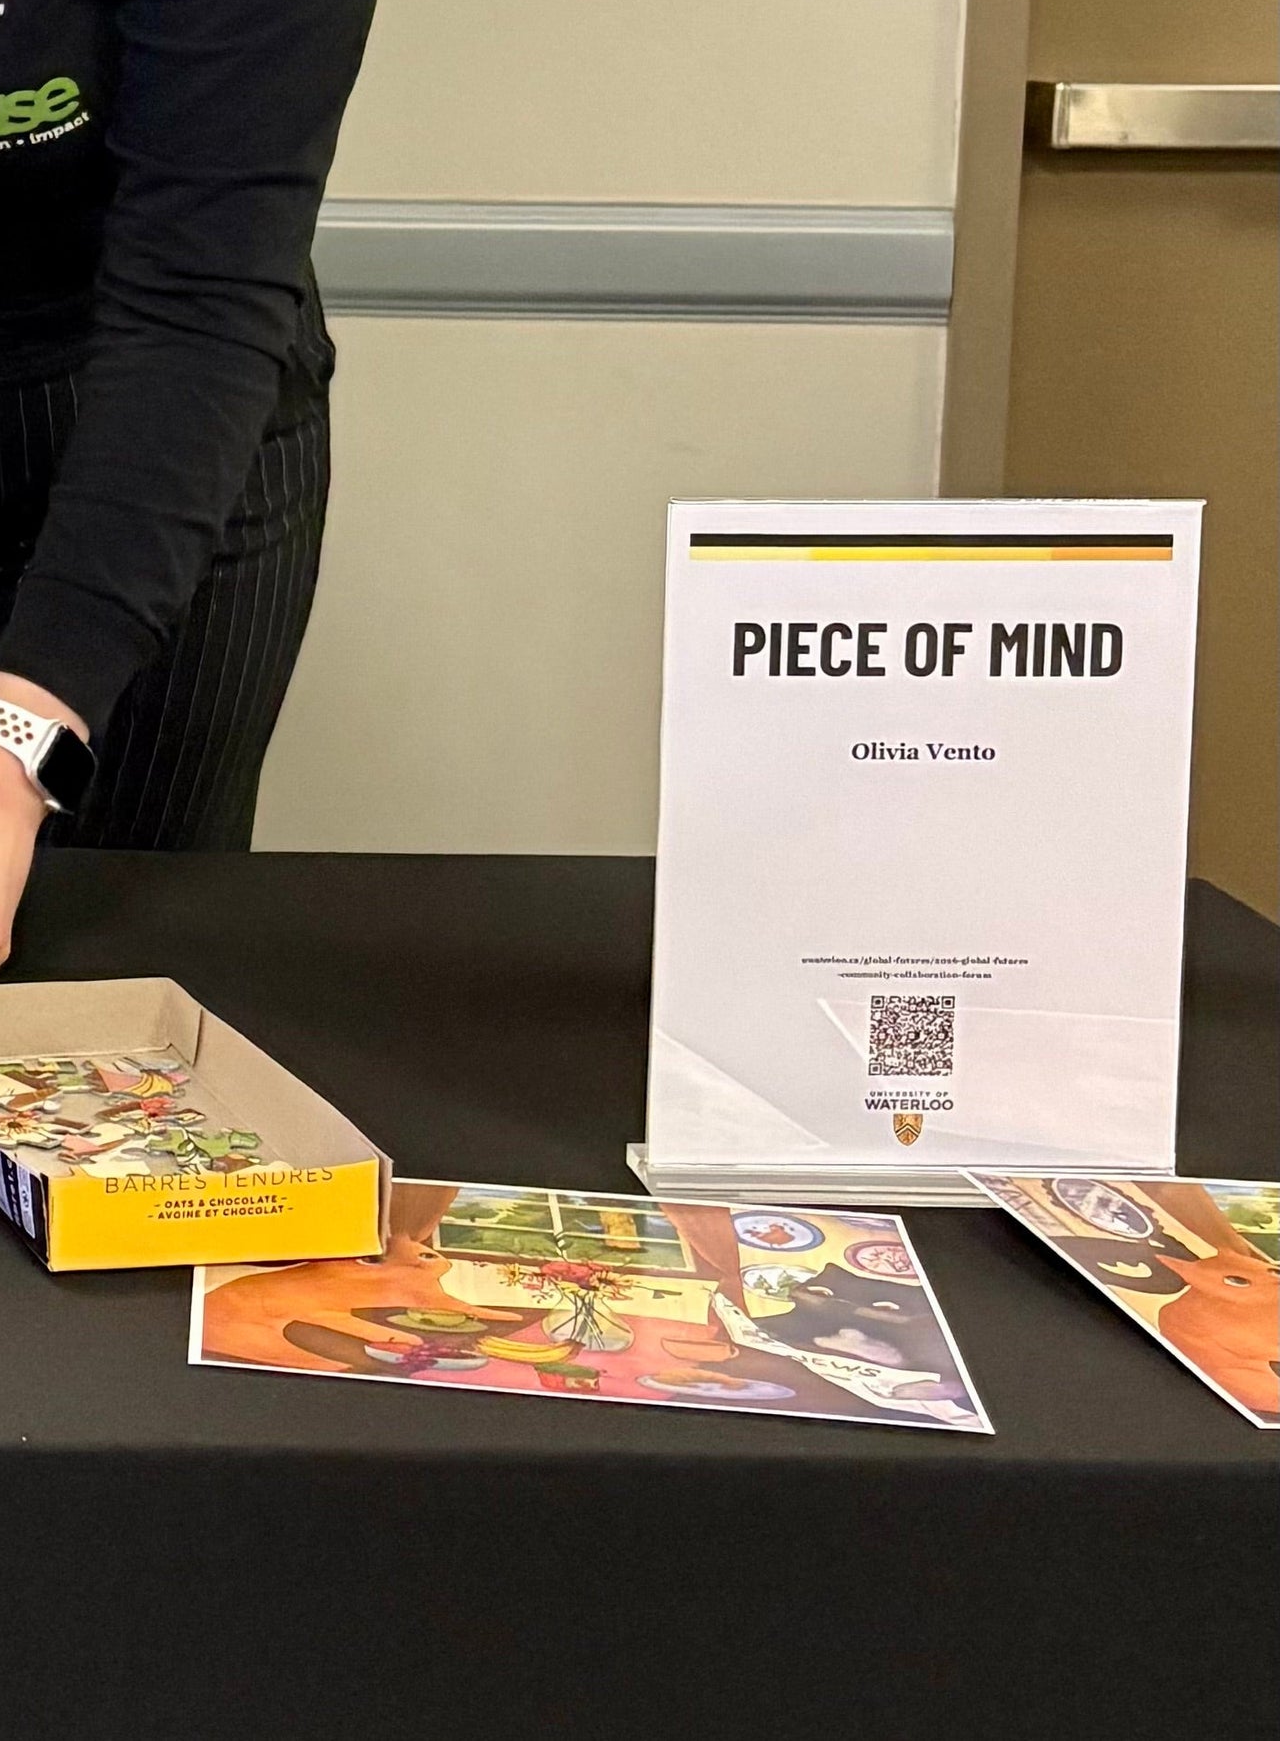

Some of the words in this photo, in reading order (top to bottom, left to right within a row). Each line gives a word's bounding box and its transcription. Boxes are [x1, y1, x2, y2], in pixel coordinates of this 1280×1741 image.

[29, 111, 91, 145] impact
[732, 621, 888, 677] PIECE
[903, 621, 973, 677] OF
[989, 622, 1124, 678] MIND
[851, 742, 920, 761] Olivia
[926, 743, 996, 761] Vento
[864, 1098, 954, 1111] WATERLOO
[105, 1172, 207, 1194] BARRES
[164, 1199, 195, 1209] OATS
[209, 1194, 279, 1207] CHOCOLATE
[222, 1205, 285, 1218] CHOCOLAT
